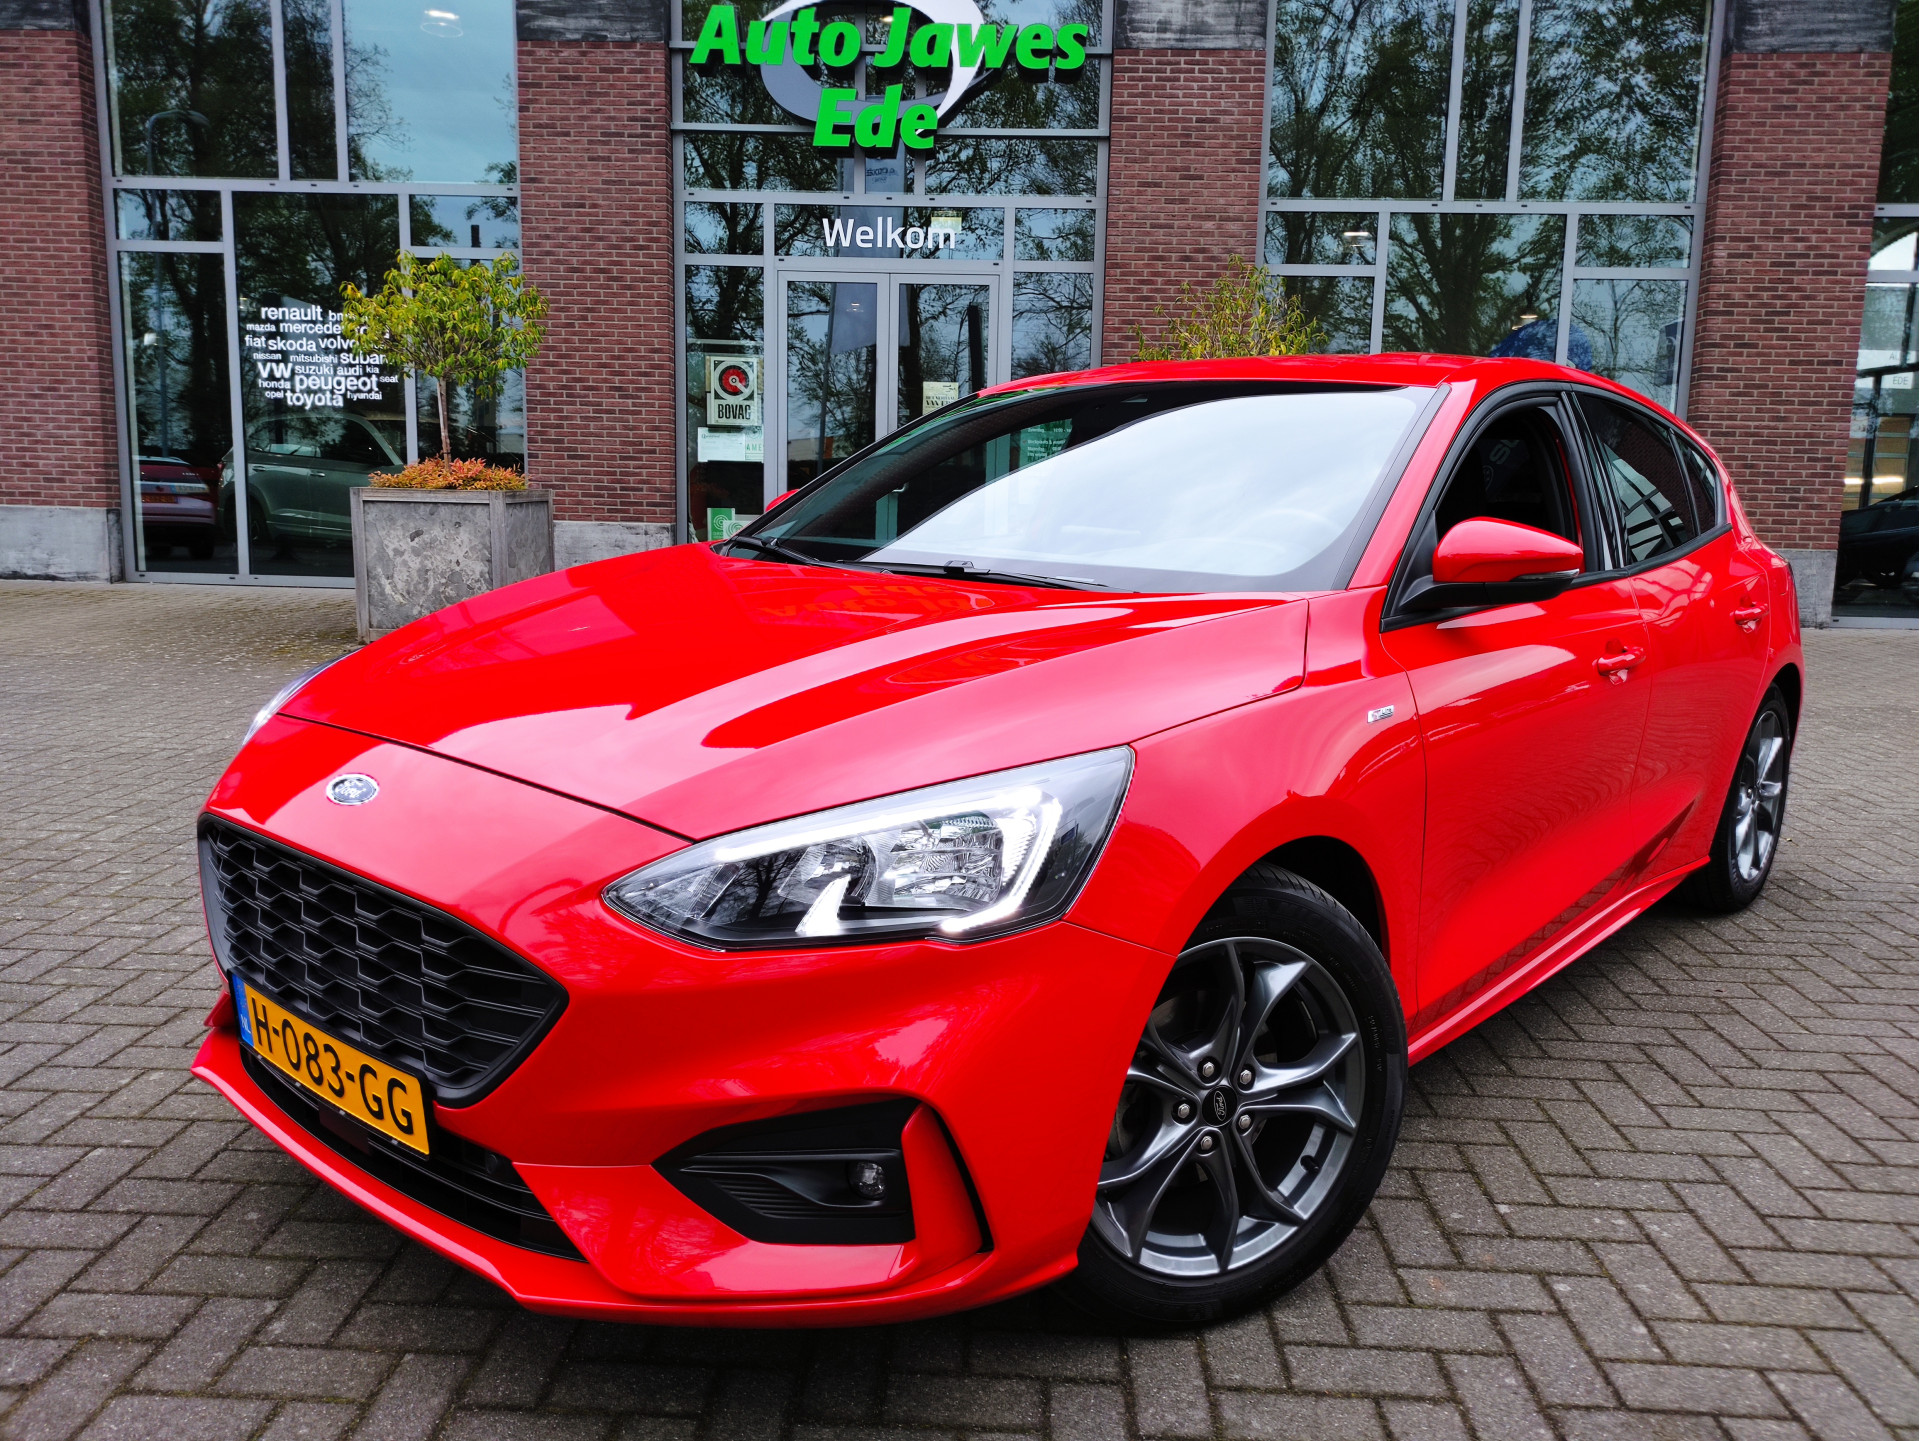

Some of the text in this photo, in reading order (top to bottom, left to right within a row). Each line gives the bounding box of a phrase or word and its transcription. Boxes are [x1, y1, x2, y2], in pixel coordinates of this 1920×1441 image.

[689, 4, 1089, 70] Auto Jawes
[812, 83, 939, 149] Ede
[822, 216, 956, 249] Welkom
[260, 304, 323, 321] renault
[246, 323, 276, 332] mazda
[279, 321, 345, 334] mercede
[244, 334, 267, 347] fiat
[268, 336, 317, 352] skoda
[252, 351, 391, 365] nissan mitsubishi subar
[257, 362, 379, 378] VW suzuki audi kia
[258, 374, 399, 394] honda peugeot seat
[264, 389, 383, 410] opel toyota hyundai
